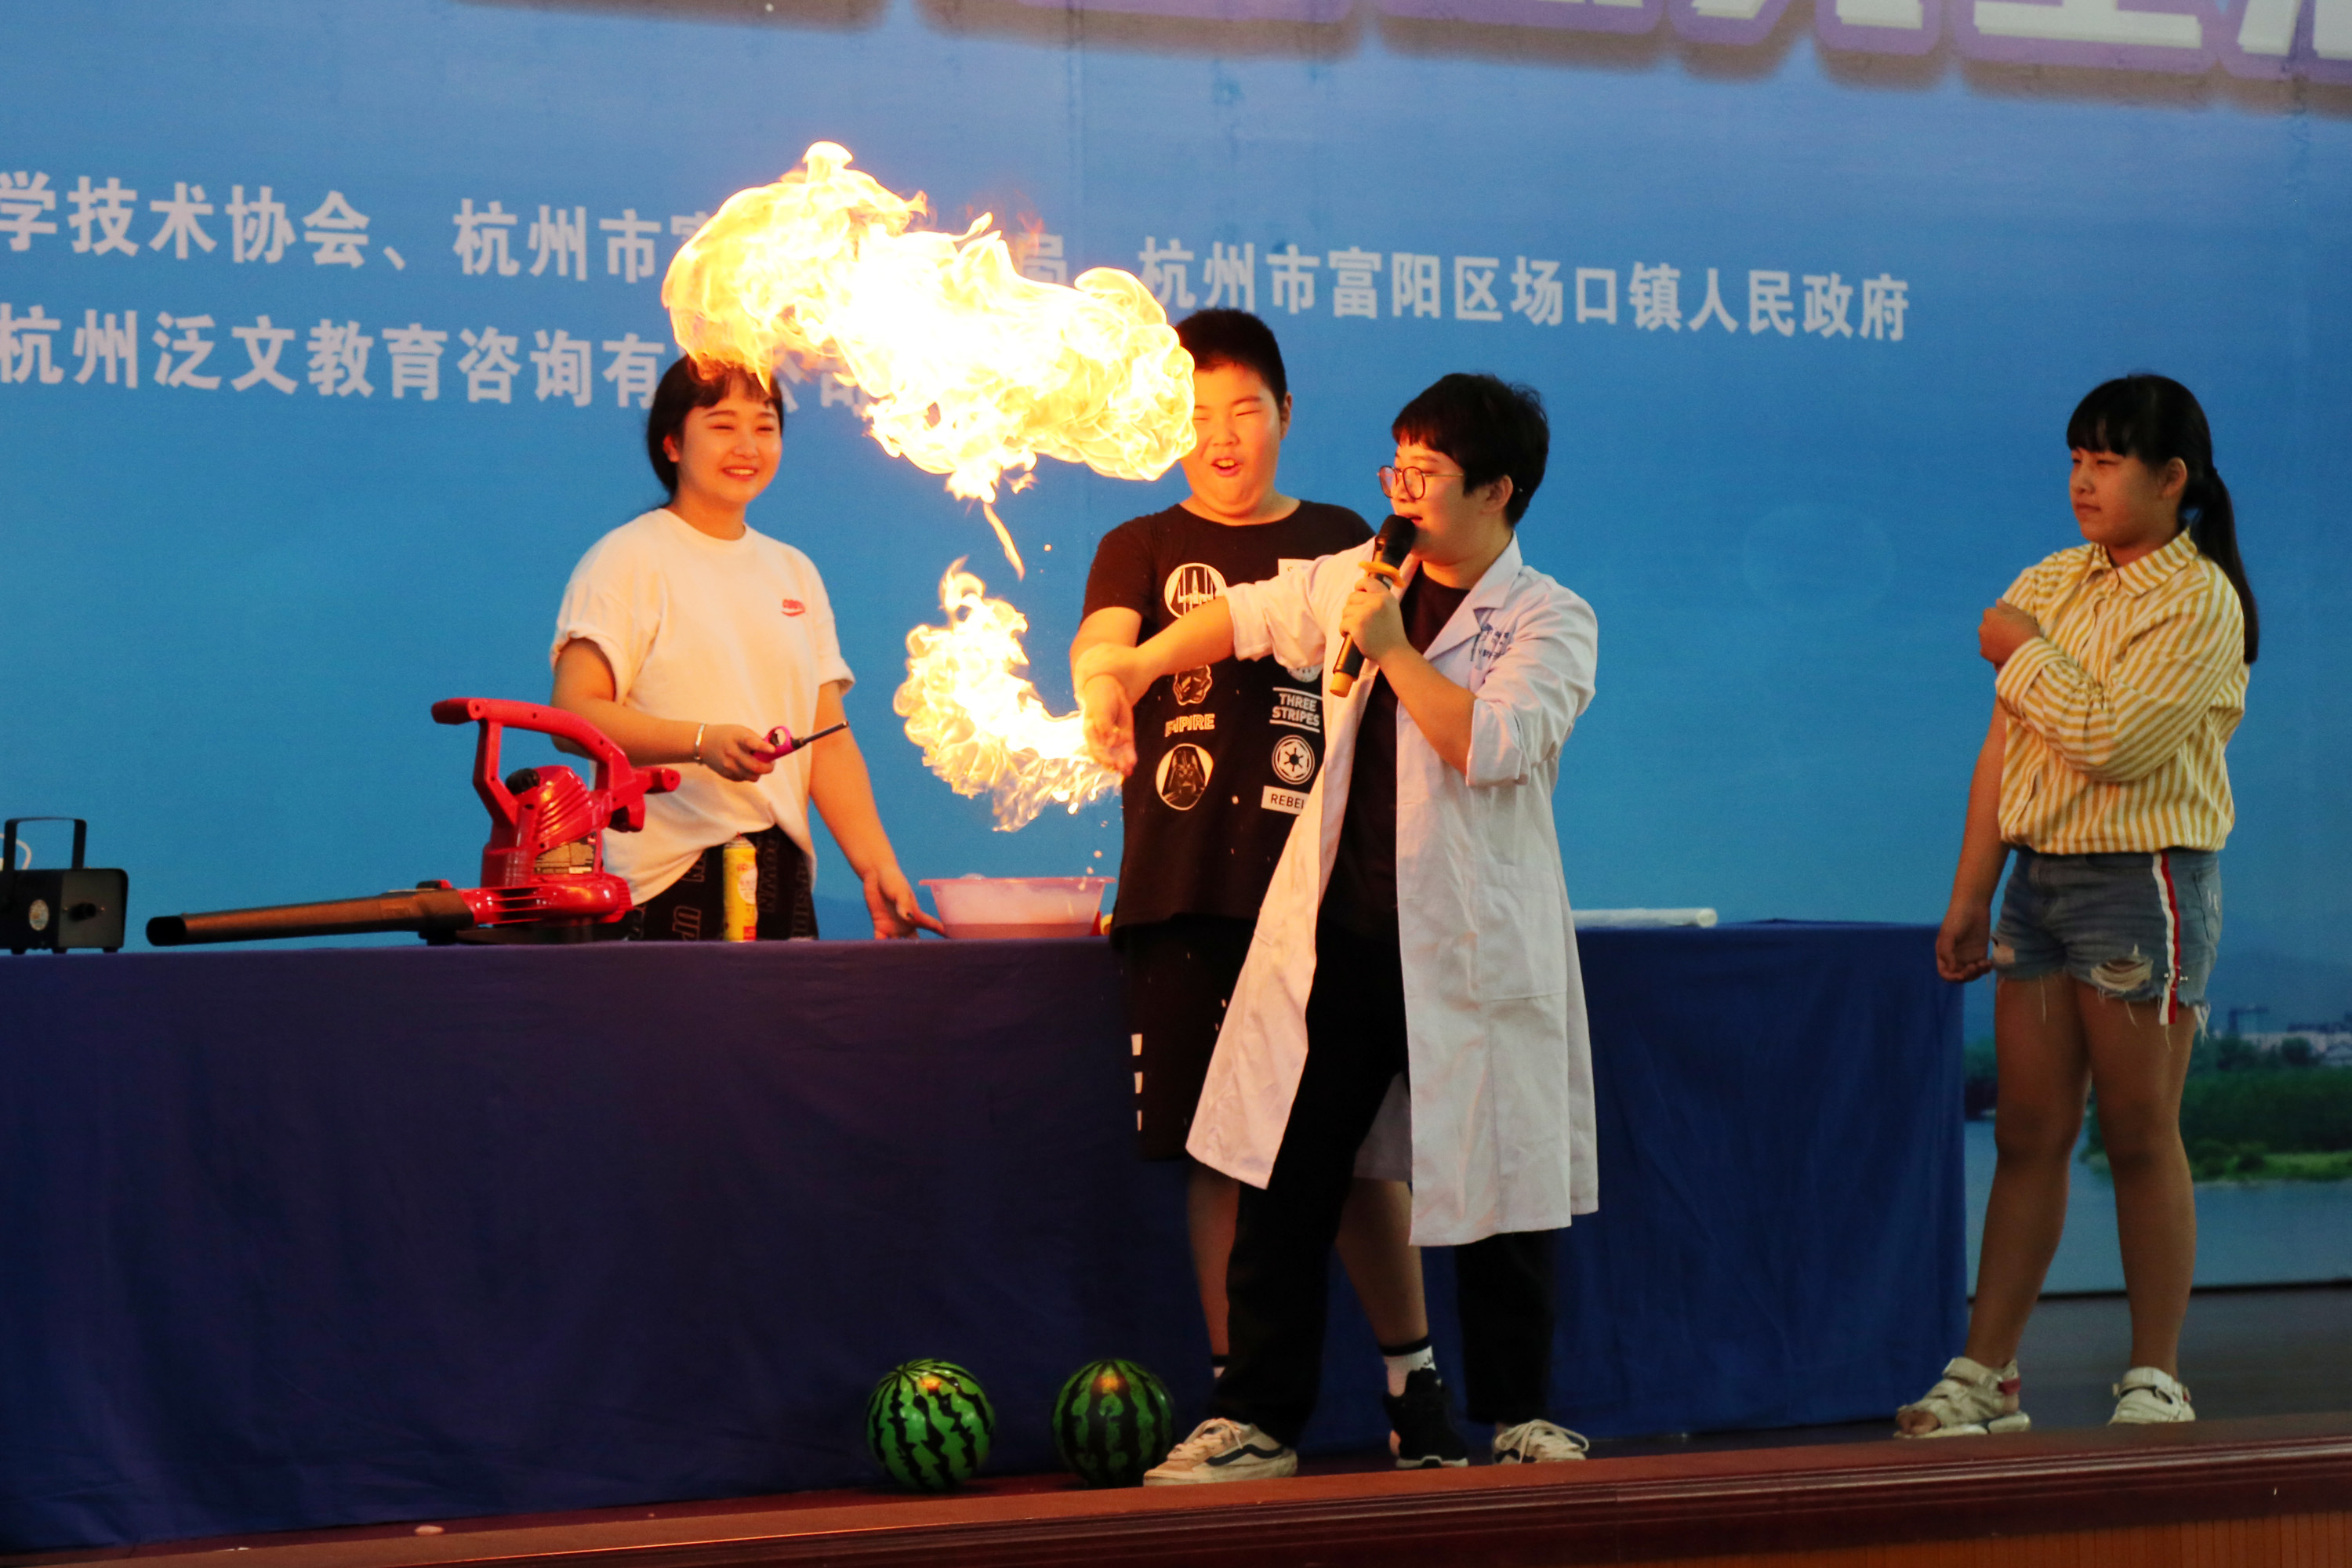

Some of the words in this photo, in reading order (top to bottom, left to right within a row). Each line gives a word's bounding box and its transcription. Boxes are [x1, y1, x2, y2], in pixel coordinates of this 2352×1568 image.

[0, 171, 709, 284] 学技术协会、杭州市
[1137, 236, 1910, 342] 杭州市富阳区场口镇人民政府
[1279, 693, 1317, 712] THREE
[1272, 706, 1320, 727] STRIPES
